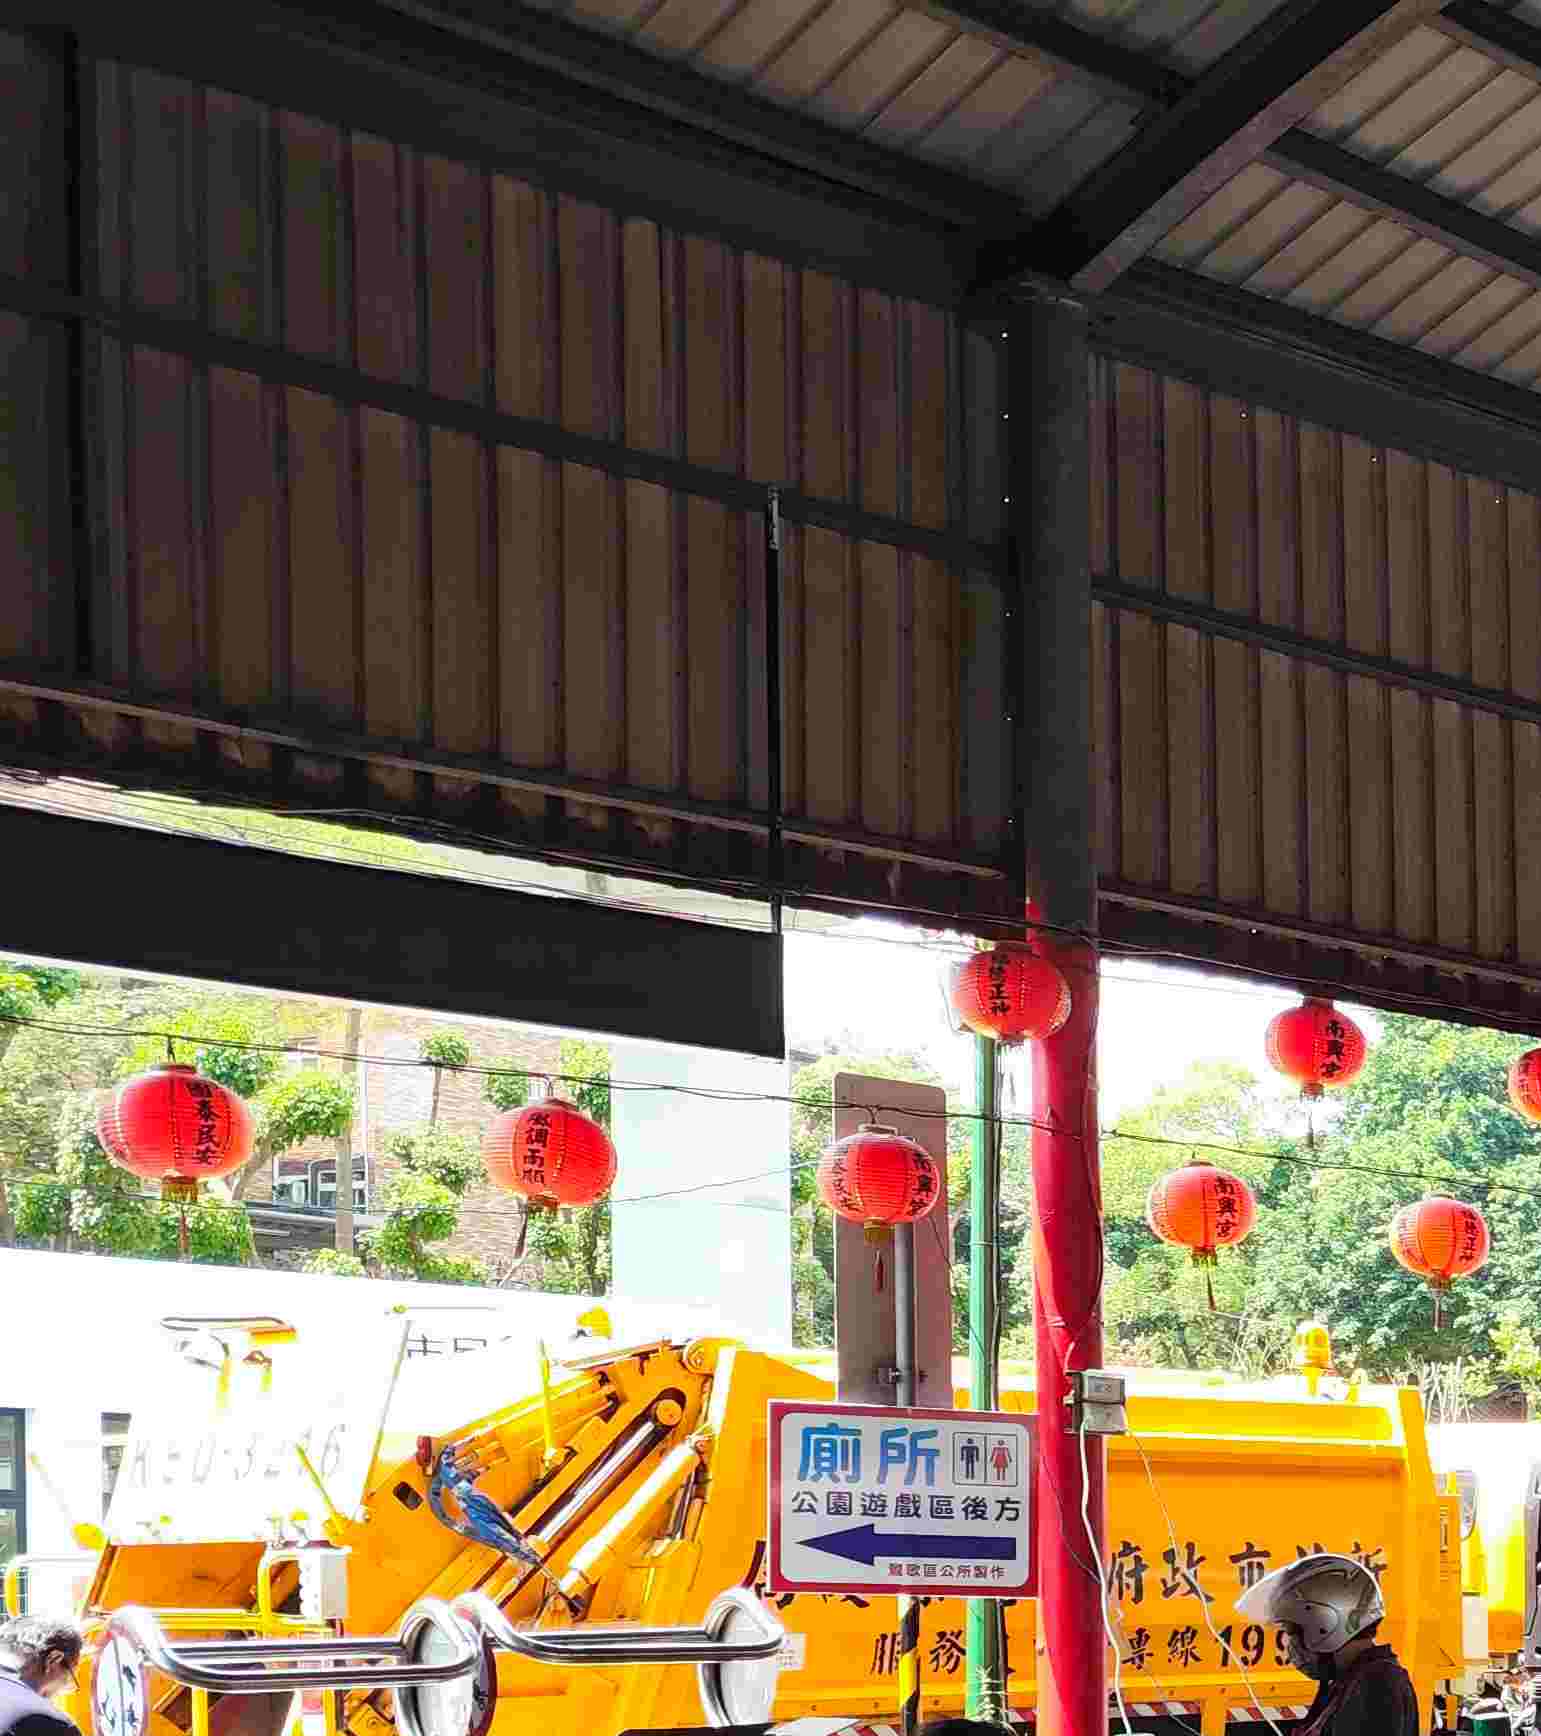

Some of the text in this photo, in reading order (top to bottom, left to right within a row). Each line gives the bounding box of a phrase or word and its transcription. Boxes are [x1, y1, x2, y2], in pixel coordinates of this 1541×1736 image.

[797, 1422, 941, 1487] 廁所
[791, 1490, 1021, 1522] 公園遊戲區後方
